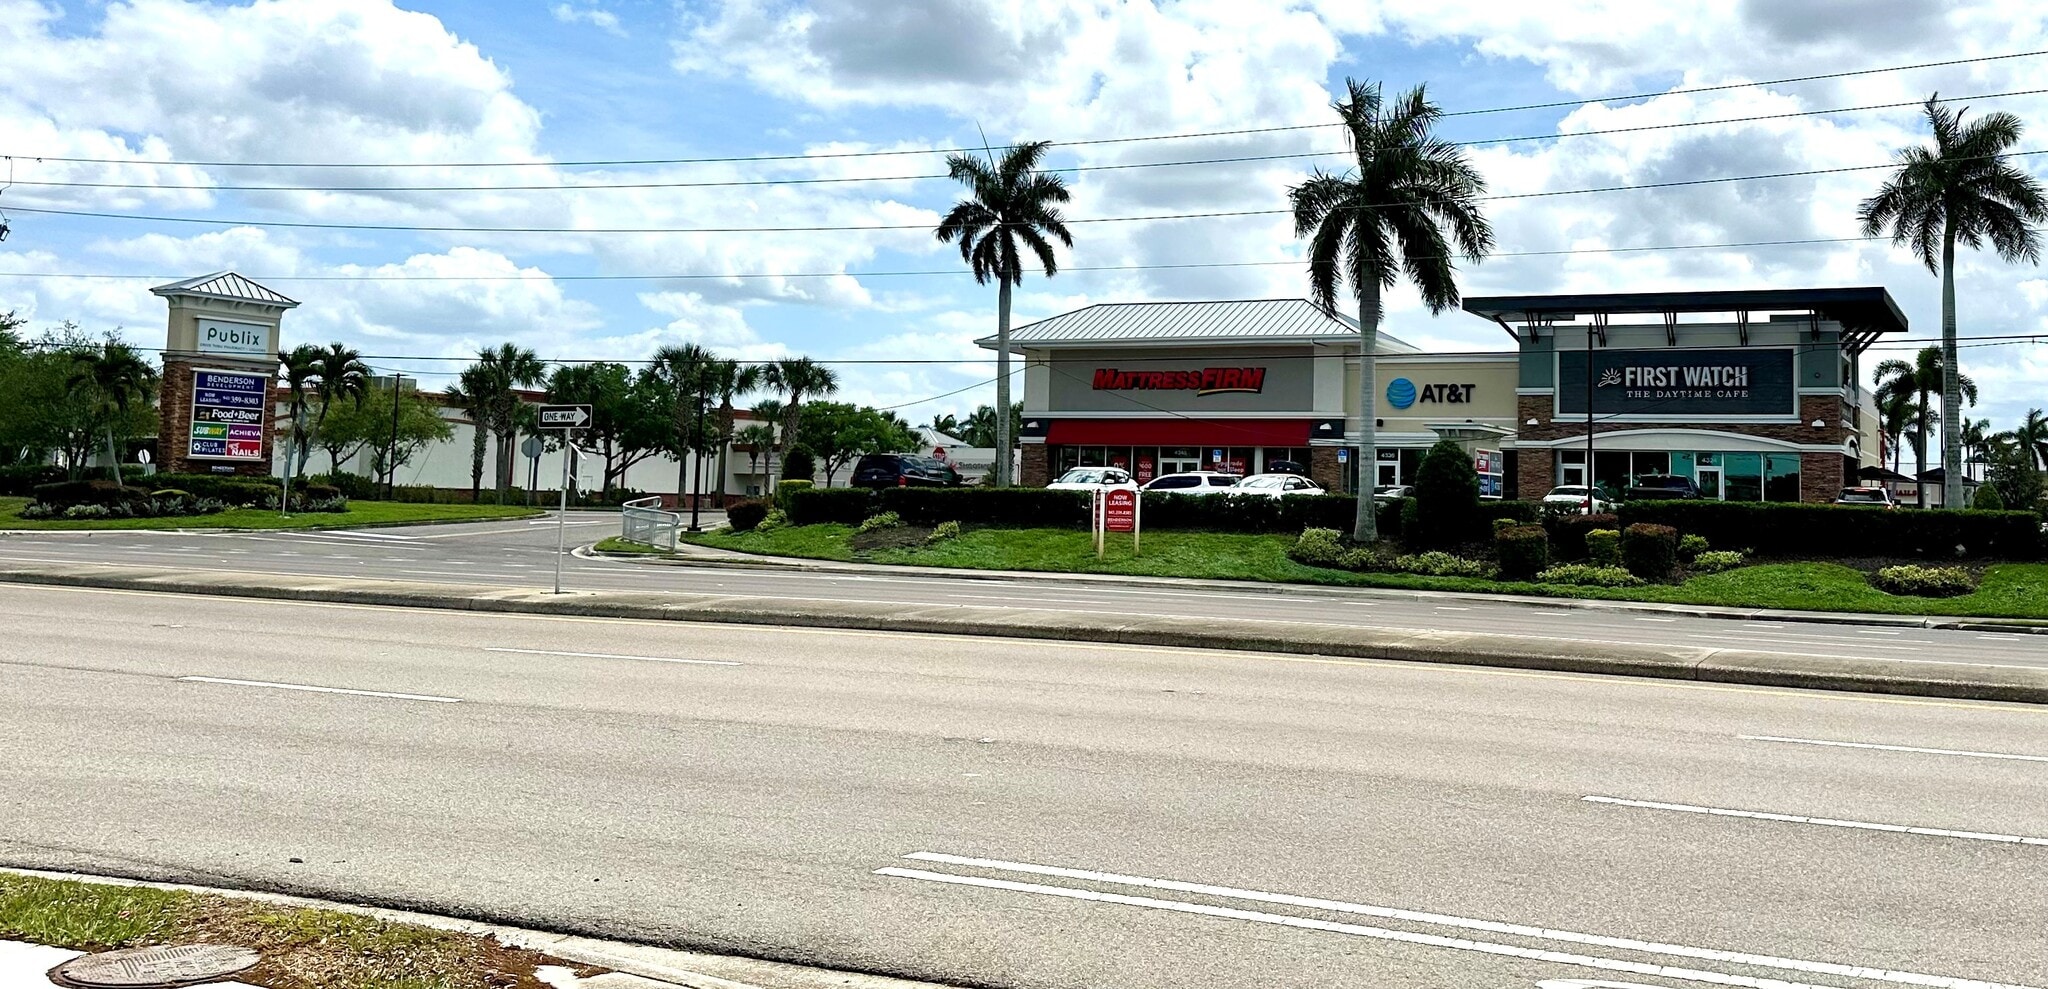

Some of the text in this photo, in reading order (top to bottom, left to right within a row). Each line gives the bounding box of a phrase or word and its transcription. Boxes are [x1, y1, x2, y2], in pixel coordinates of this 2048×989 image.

[207, 327, 260, 346] Publix
[207, 374, 255, 386] BENDERSON
[1625, 366, 1749, 388] FIRST WATCH
[207, 382, 255, 390] DEVELOPMENT
[1419, 383, 1477, 404] AT&T
[1627, 390, 1749, 398] THE DAYTIME CAFE
[544, 412, 576, 421] ONE WAY
[193, 426, 227, 435] SUBWAY
[229, 429, 261, 437] ACHIEVA
[231, 448, 259, 457] NAILS
